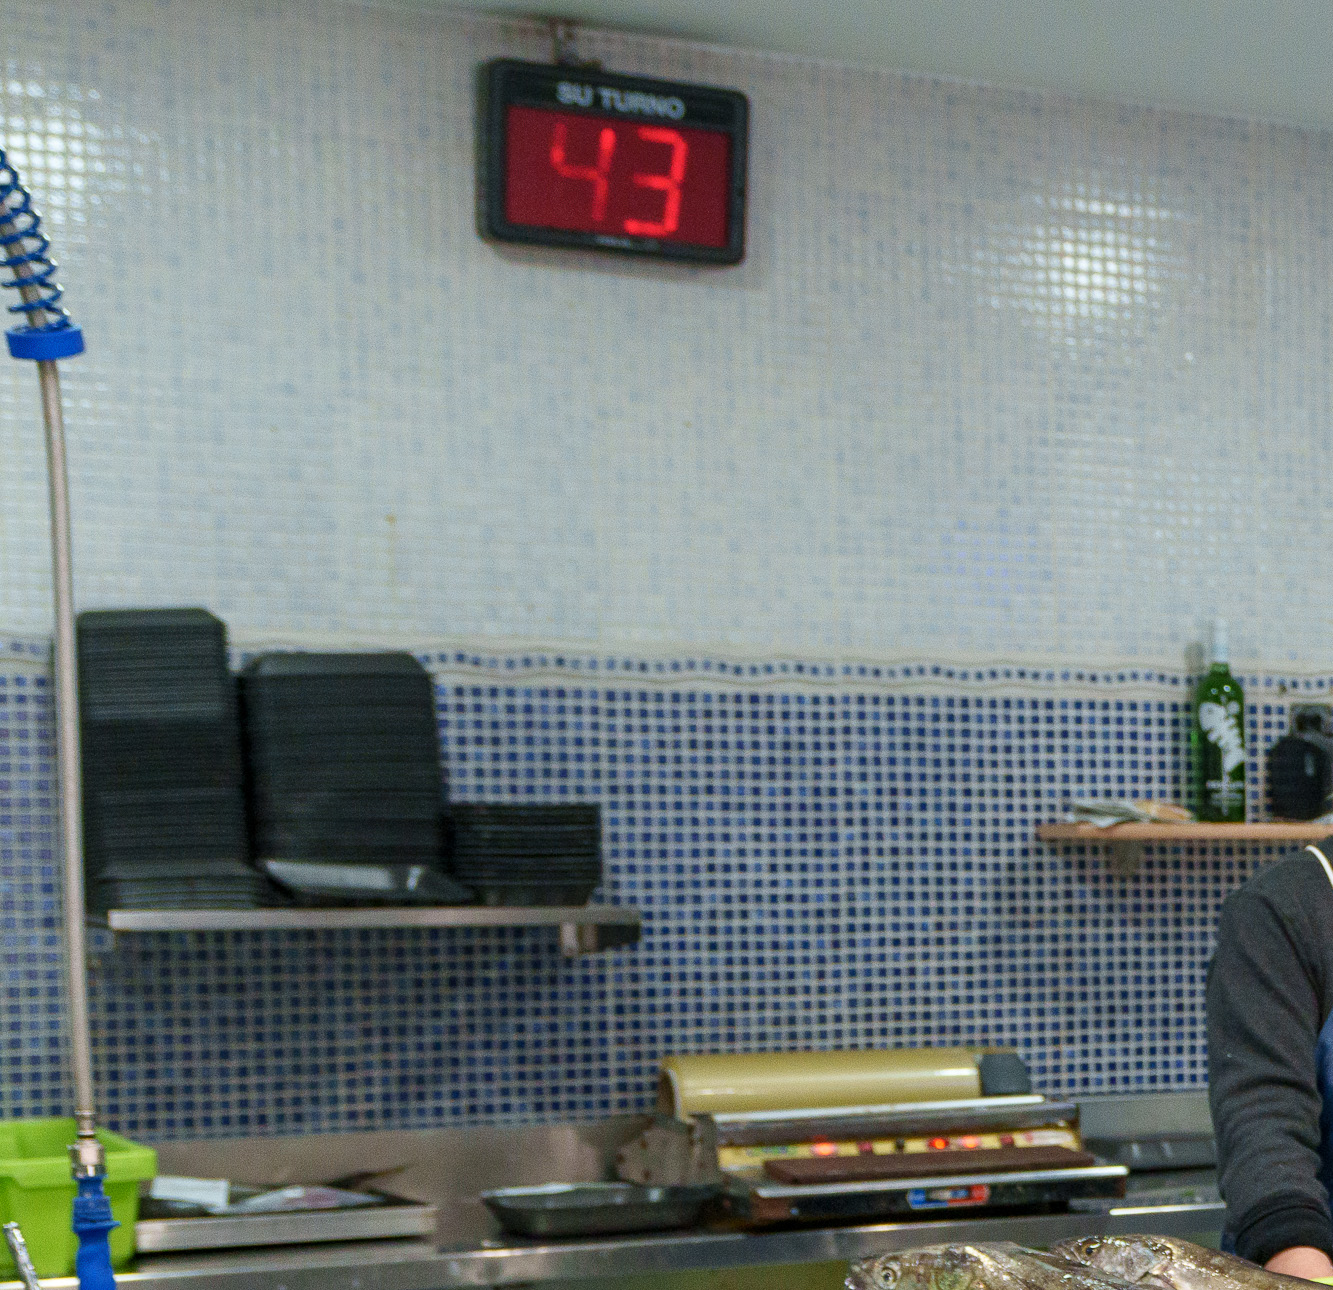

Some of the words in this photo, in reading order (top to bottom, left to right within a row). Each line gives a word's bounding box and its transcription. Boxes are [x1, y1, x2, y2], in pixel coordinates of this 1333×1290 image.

[557, 81, 593, 107] SU
[598, 87, 685, 119] TURNO
[551, 122, 688, 236] 43
